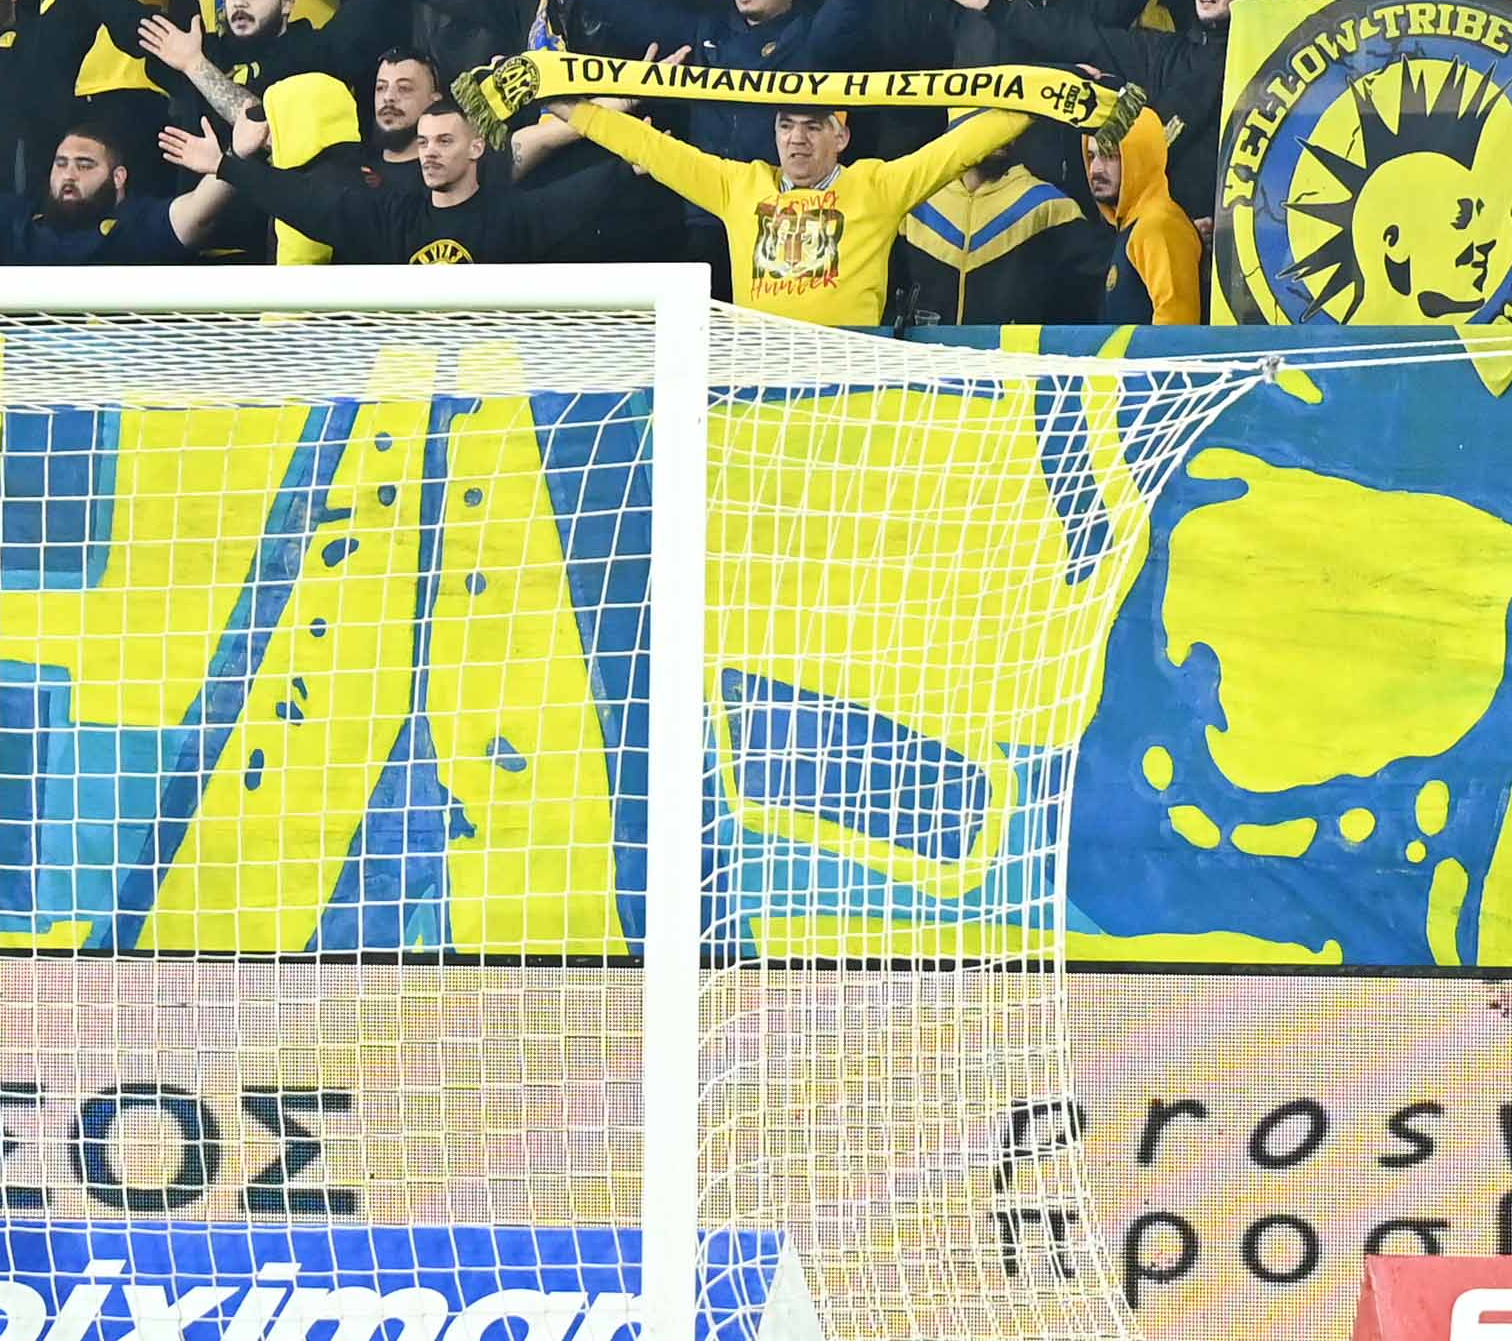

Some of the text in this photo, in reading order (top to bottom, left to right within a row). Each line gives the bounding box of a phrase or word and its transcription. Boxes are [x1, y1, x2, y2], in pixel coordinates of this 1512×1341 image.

[560, 56, 627, 86] ΤΟΥ
[640, 60, 831, 100] ΛΙΜΑΝΙΟΥ
[885, 71, 1026, 102] ΙΣΤΟΡΙΑ
[1220, 16, 1358, 210] YELLOW
